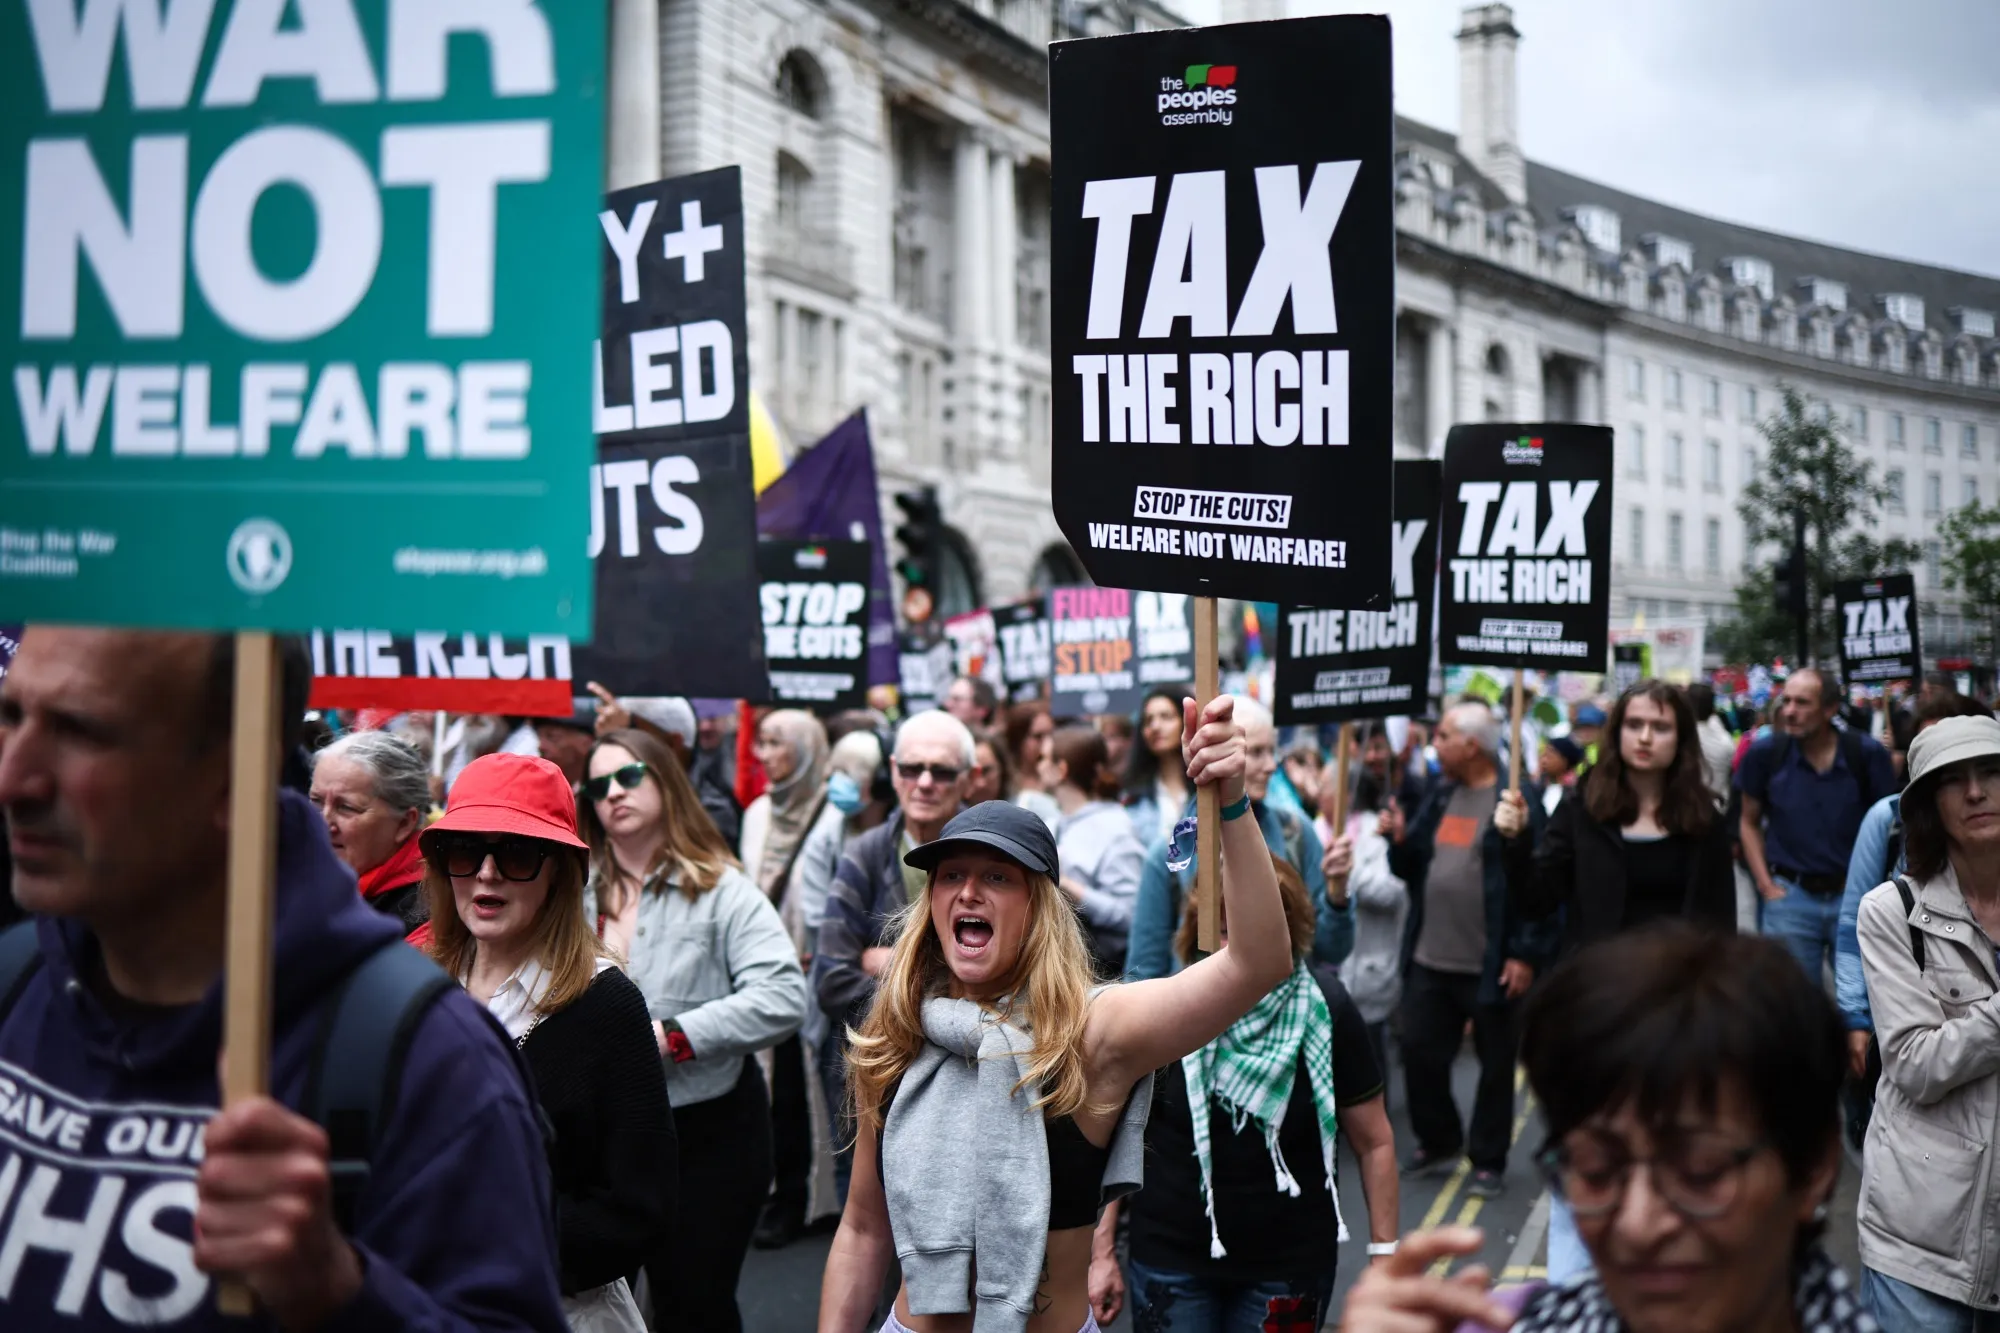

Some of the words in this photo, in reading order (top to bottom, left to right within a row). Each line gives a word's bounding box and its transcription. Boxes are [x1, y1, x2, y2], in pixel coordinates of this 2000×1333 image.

[1158, 86, 1237, 113] peoples
[1161, 77, 1183, 91] the
[1162, 108, 1232, 126] assembly
[20, 119, 553, 343] NOT
[1082, 159, 1363, 340] TAX
[13, 359, 533, 460] WELFARE
[1073, 353, 1181, 444] THE
[1190, 349, 1350, 447] RICH
[1138, 490, 1186, 516] STOP
[1189, 494, 1224, 519] THE
[1227, 497, 1288, 523] CUTS!
[1458, 480, 1600, 556] TAX
[1088, 522, 1181, 556] WELFARE
[1184, 530, 1226, 559] NOT
[1230, 534, 1347, 568] WARFARE!
[760, 582, 866, 626] STOP
[1450, 559, 1509, 603] THE
[1511, 559, 1592, 604] RICH
[1288, 608, 1345, 659] THE
[1346, 600, 1419, 652] RICH
[1843, 595, 1910, 635] TAX
[799, 624, 864, 660] CUTS
[1055, 638, 1132, 676] STOP
[0, 1077, 91, 1151] SAVE
